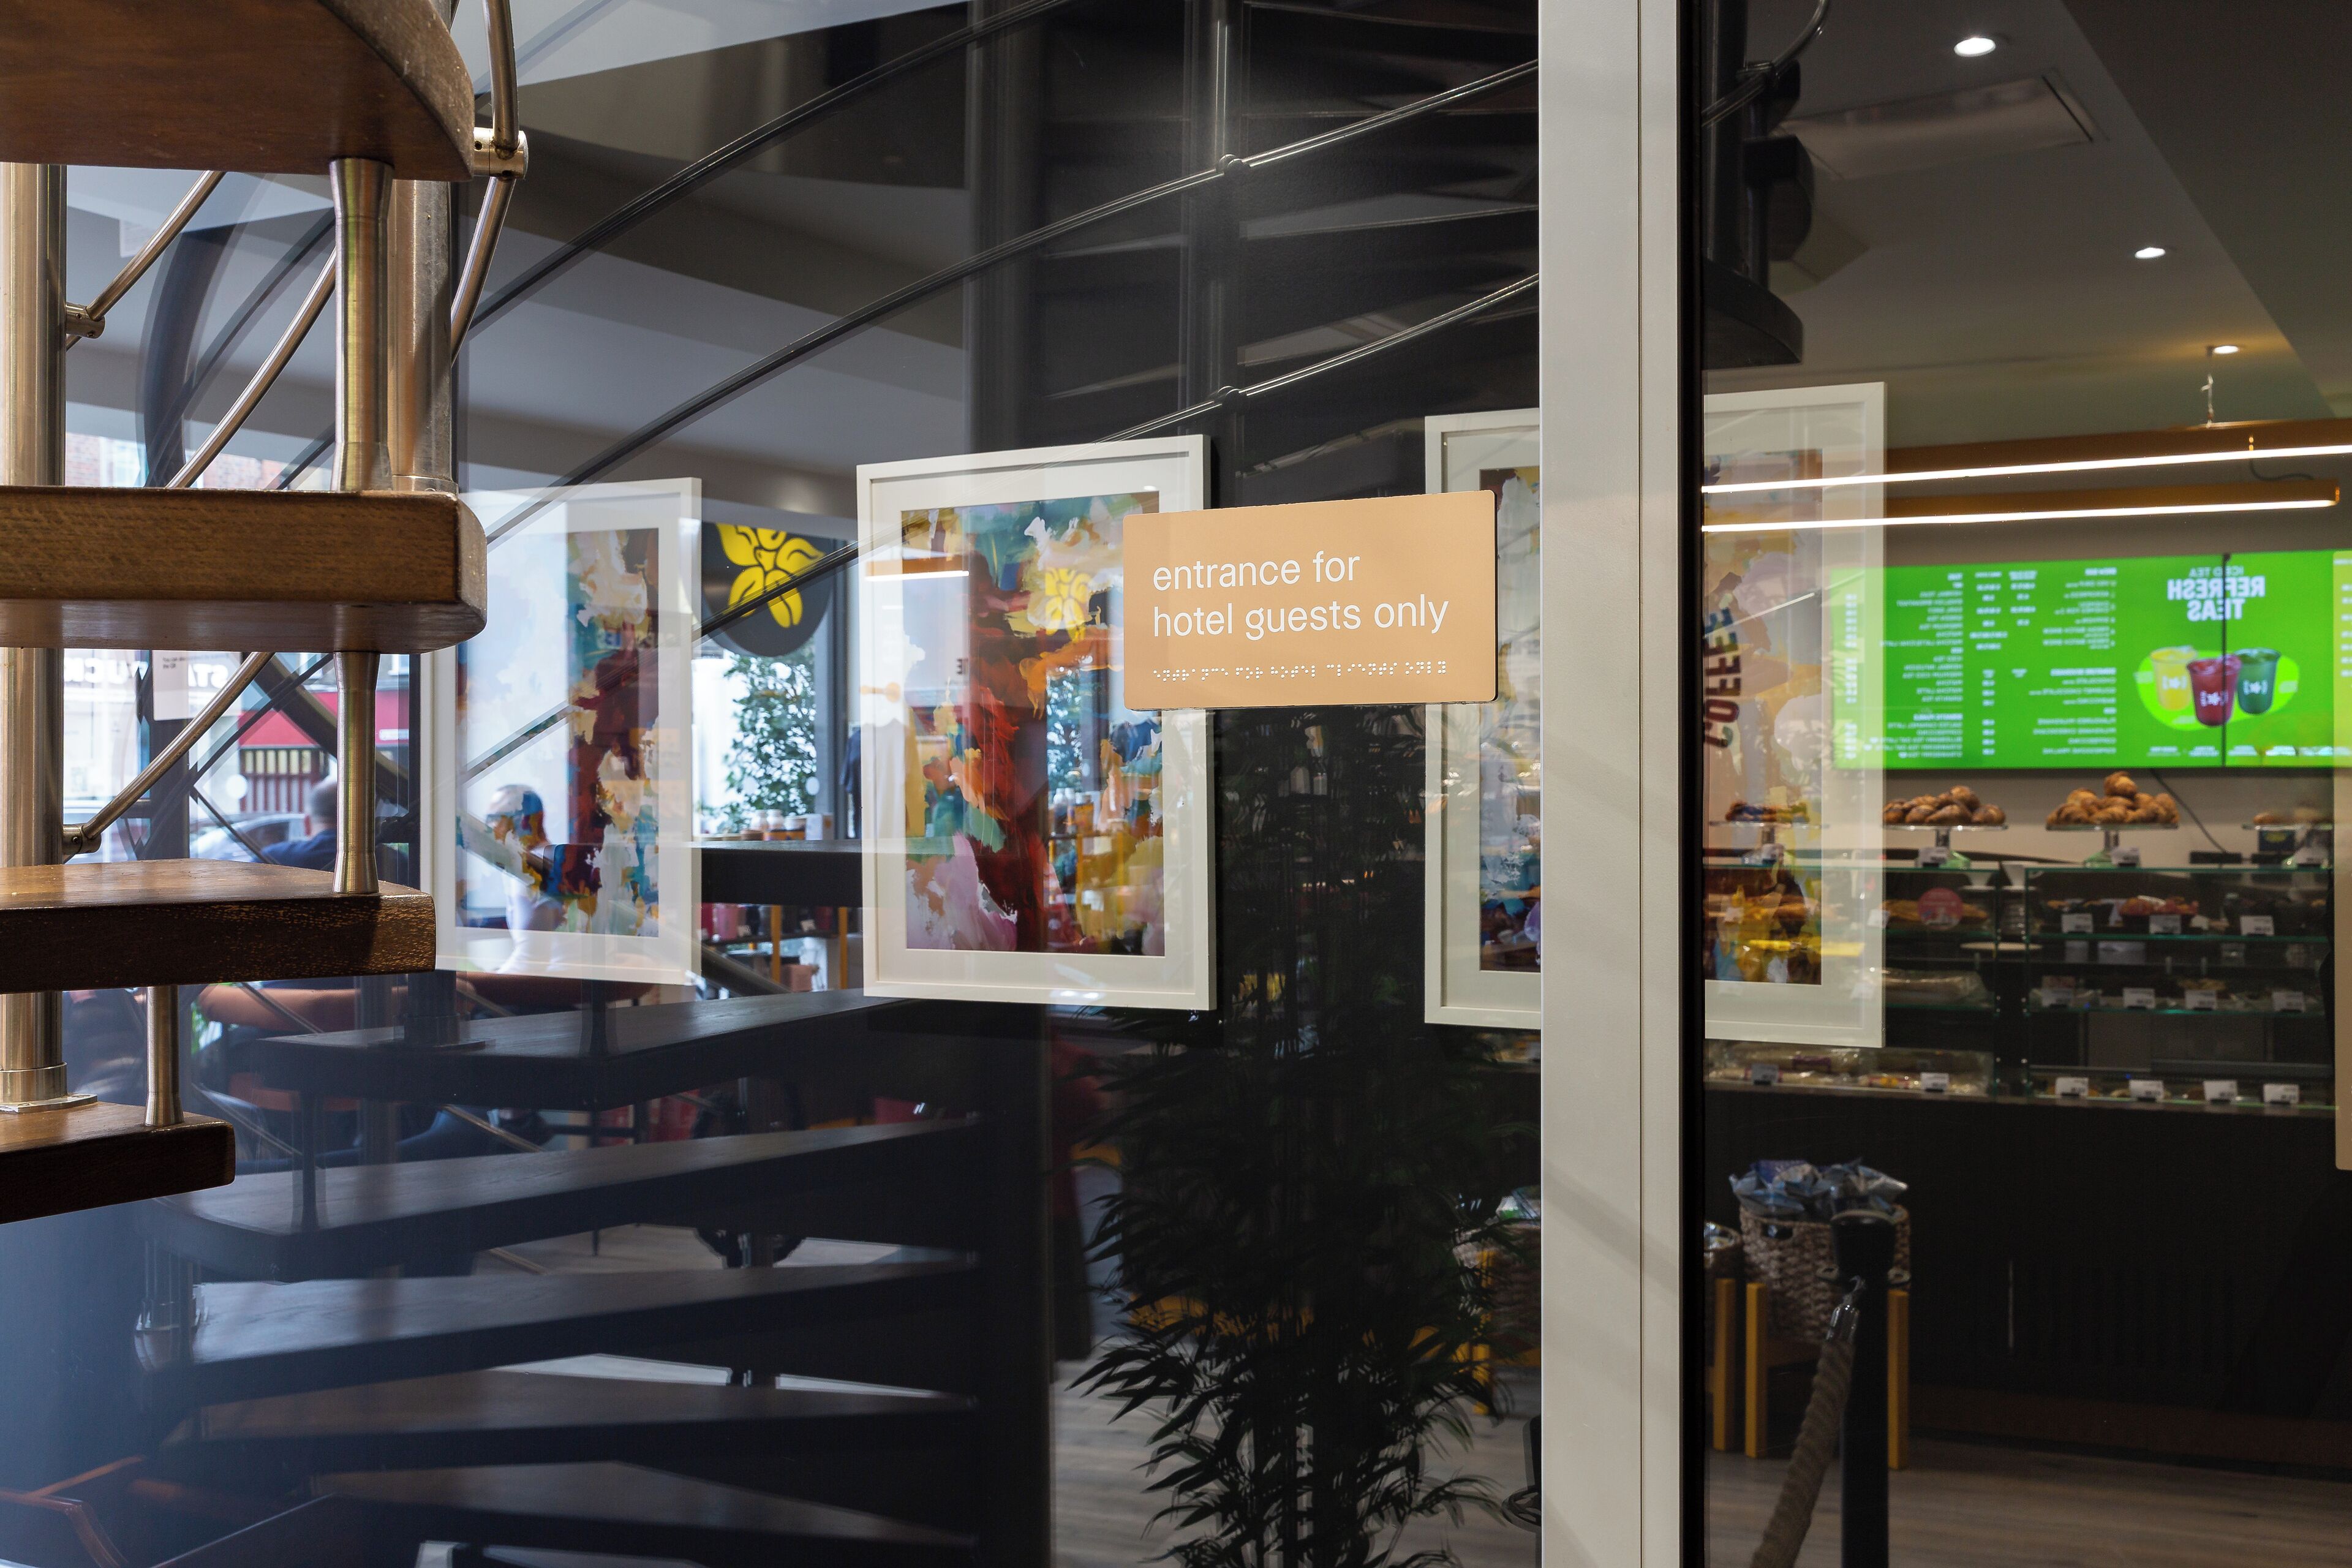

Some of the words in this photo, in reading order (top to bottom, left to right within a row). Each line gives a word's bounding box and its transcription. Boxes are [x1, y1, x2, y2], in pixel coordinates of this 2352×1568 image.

[1153, 560, 1301, 591] entrance
[1313, 550, 1360, 582] for
[1154, 603, 1233, 637] hotel
[1245, 600, 1361, 641] guests
[1374, 594, 1450, 634] only
